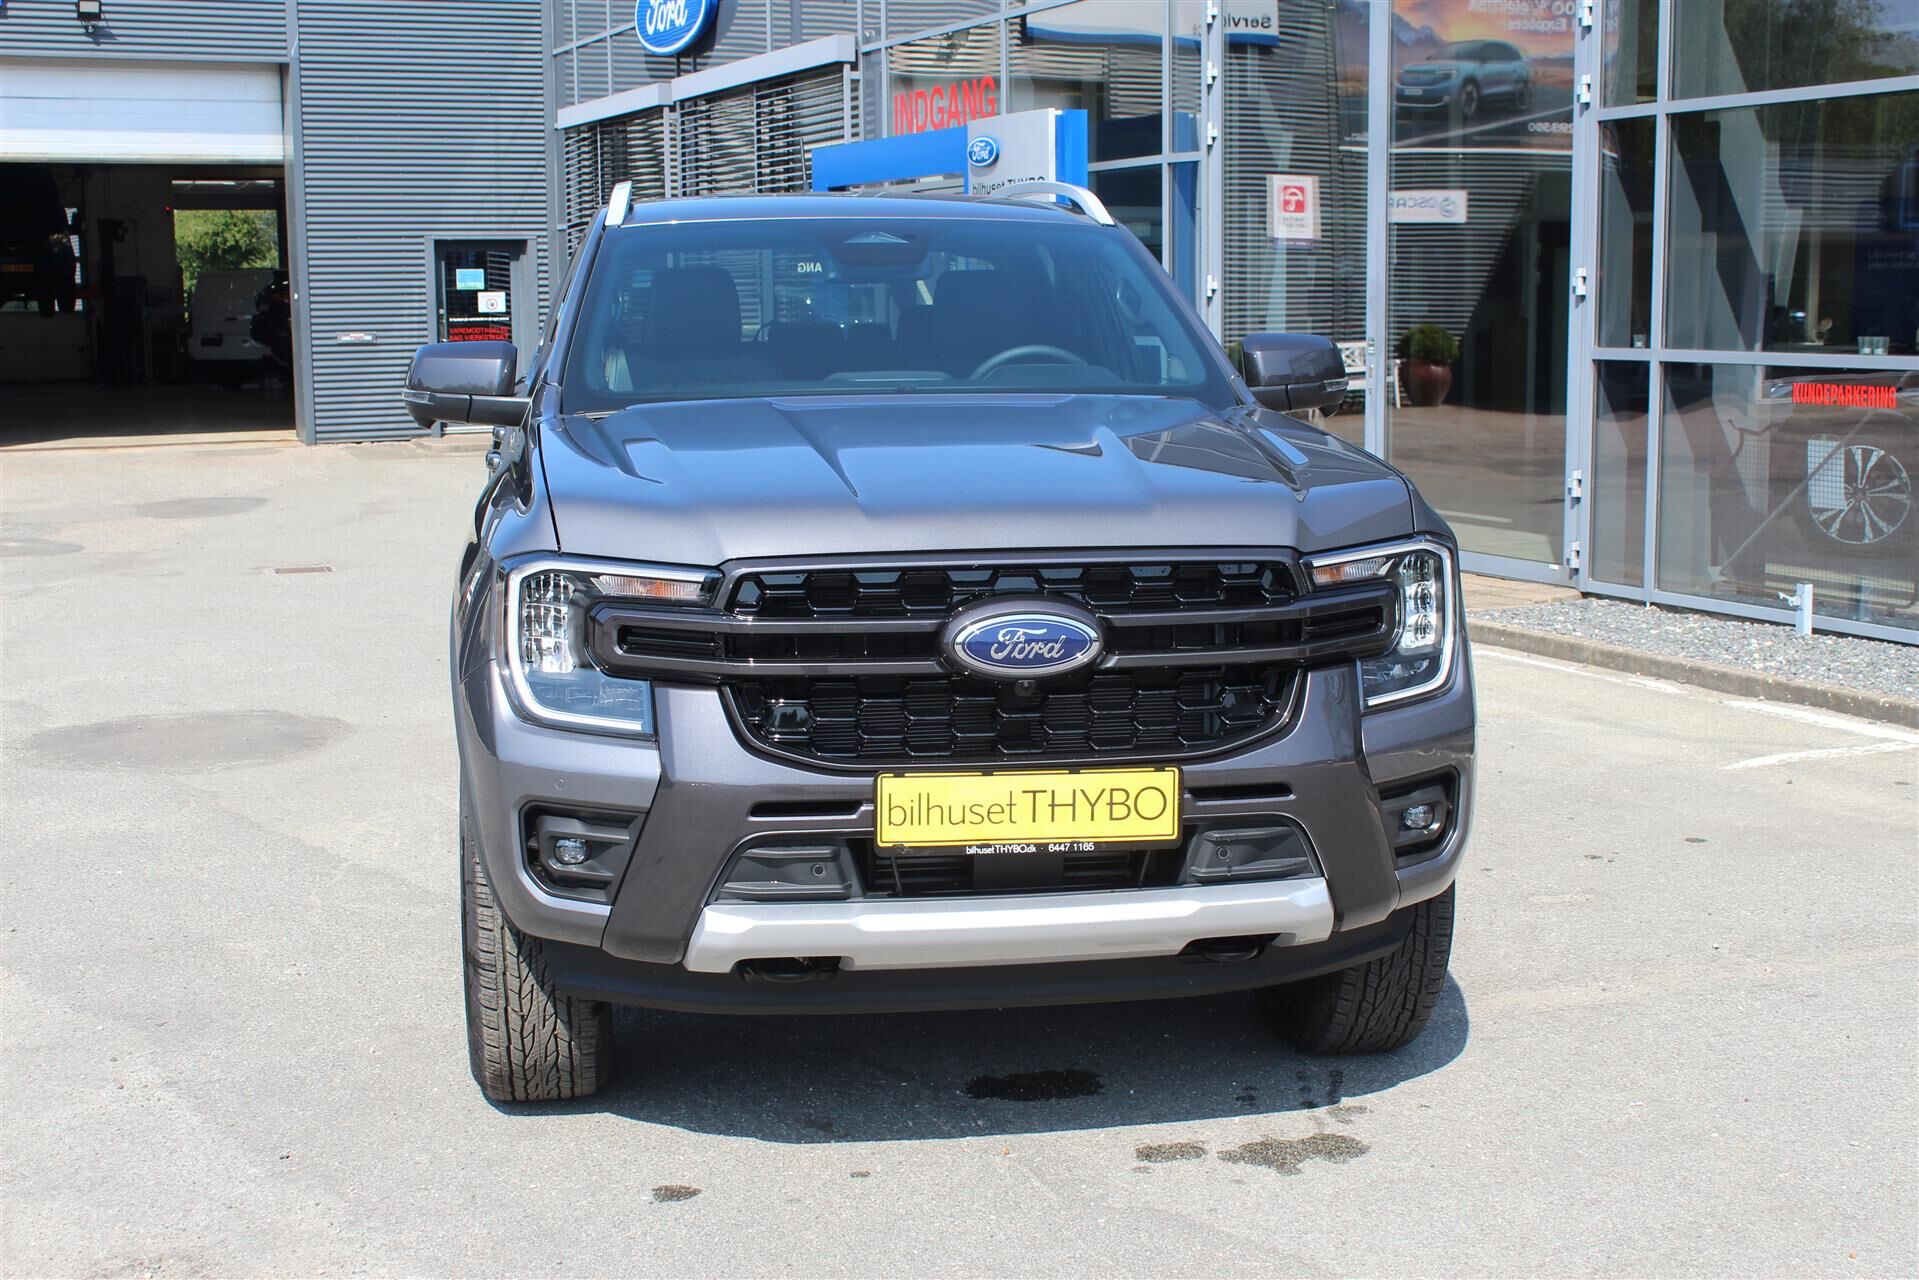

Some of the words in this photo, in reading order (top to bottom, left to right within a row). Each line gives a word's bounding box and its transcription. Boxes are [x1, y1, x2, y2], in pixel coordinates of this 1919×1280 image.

[893, 75, 997, 136] INDGANG
[970, 142, 990, 161] Ford
[1792, 382, 1897, 408] KUNDEPARKERING
[991, 628, 1065, 660] Ford
[1048, 843, 1070, 852] 6447
[1073, 842, 1095, 852] 1165
